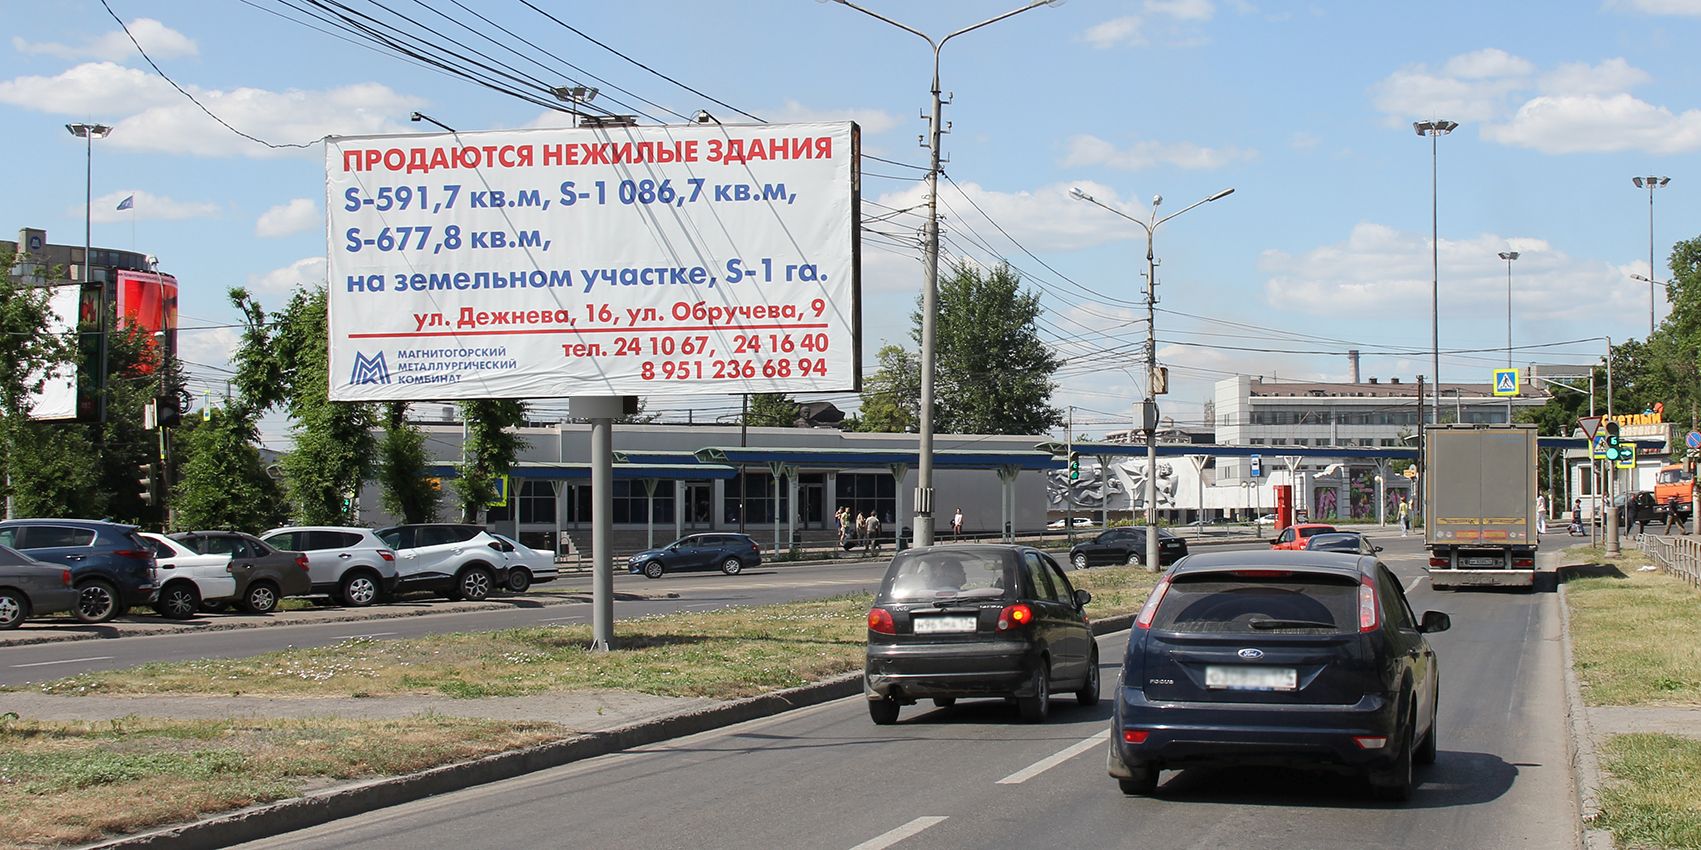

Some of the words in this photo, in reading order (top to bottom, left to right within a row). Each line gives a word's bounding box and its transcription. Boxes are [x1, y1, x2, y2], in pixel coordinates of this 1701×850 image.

[344, 145, 533, 174] ПРОДАЮТСЯ
[543, 140, 698, 166] НЕЖИЛЫЕ
[707, 137, 832, 166] ЗДАНИЯ
[345, 185, 460, 214] S-591,7
[471, 190, 551, 211] кв.м,
[560, 181, 605, 205] S-1
[619, 178, 704, 207] 086,7
[715, 184, 798, 206] кв.м,
[347, 225, 461, 253] S-677,8
[471, 231, 552, 250] кв.м,
[347, 275, 384, 292] на
[394, 270, 573, 292] земельном
[580, 266, 717, 293] участке,
[726, 258, 771, 283] S-1
[787, 264, 827, 281] га.
[413, 313, 451, 332] ул.
[457, 307, 576, 329] Дежнева,
[587, 304, 619, 324] 16,
[626, 308, 665, 327] ул.
[672, 301, 804, 325] Обручева,
[811, 299, 825, 317] 9
[398, 345, 507, 360] МАГНИТОГОРСКИЙ
[563, 344, 607, 357] тел.
[614, 337, 641, 356] 24
[650, 336, 675, 355] 10
[682, 336, 715, 359] 67,
[732, 335, 761, 354] 24
[770, 335, 795, 353] 16
[801, 333, 829, 352] 40
[398, 358, 517, 372] МЕТАЛЛУРГИЧЕСКИЙ
[641, 361, 655, 380] 8
[662, 361, 702, 380] 951
[713, 360, 756, 379] 236
[762, 358, 791, 378] 68
[798, 358, 827, 377] 94
[398, 374, 462, 385] КОМБИНАТ
